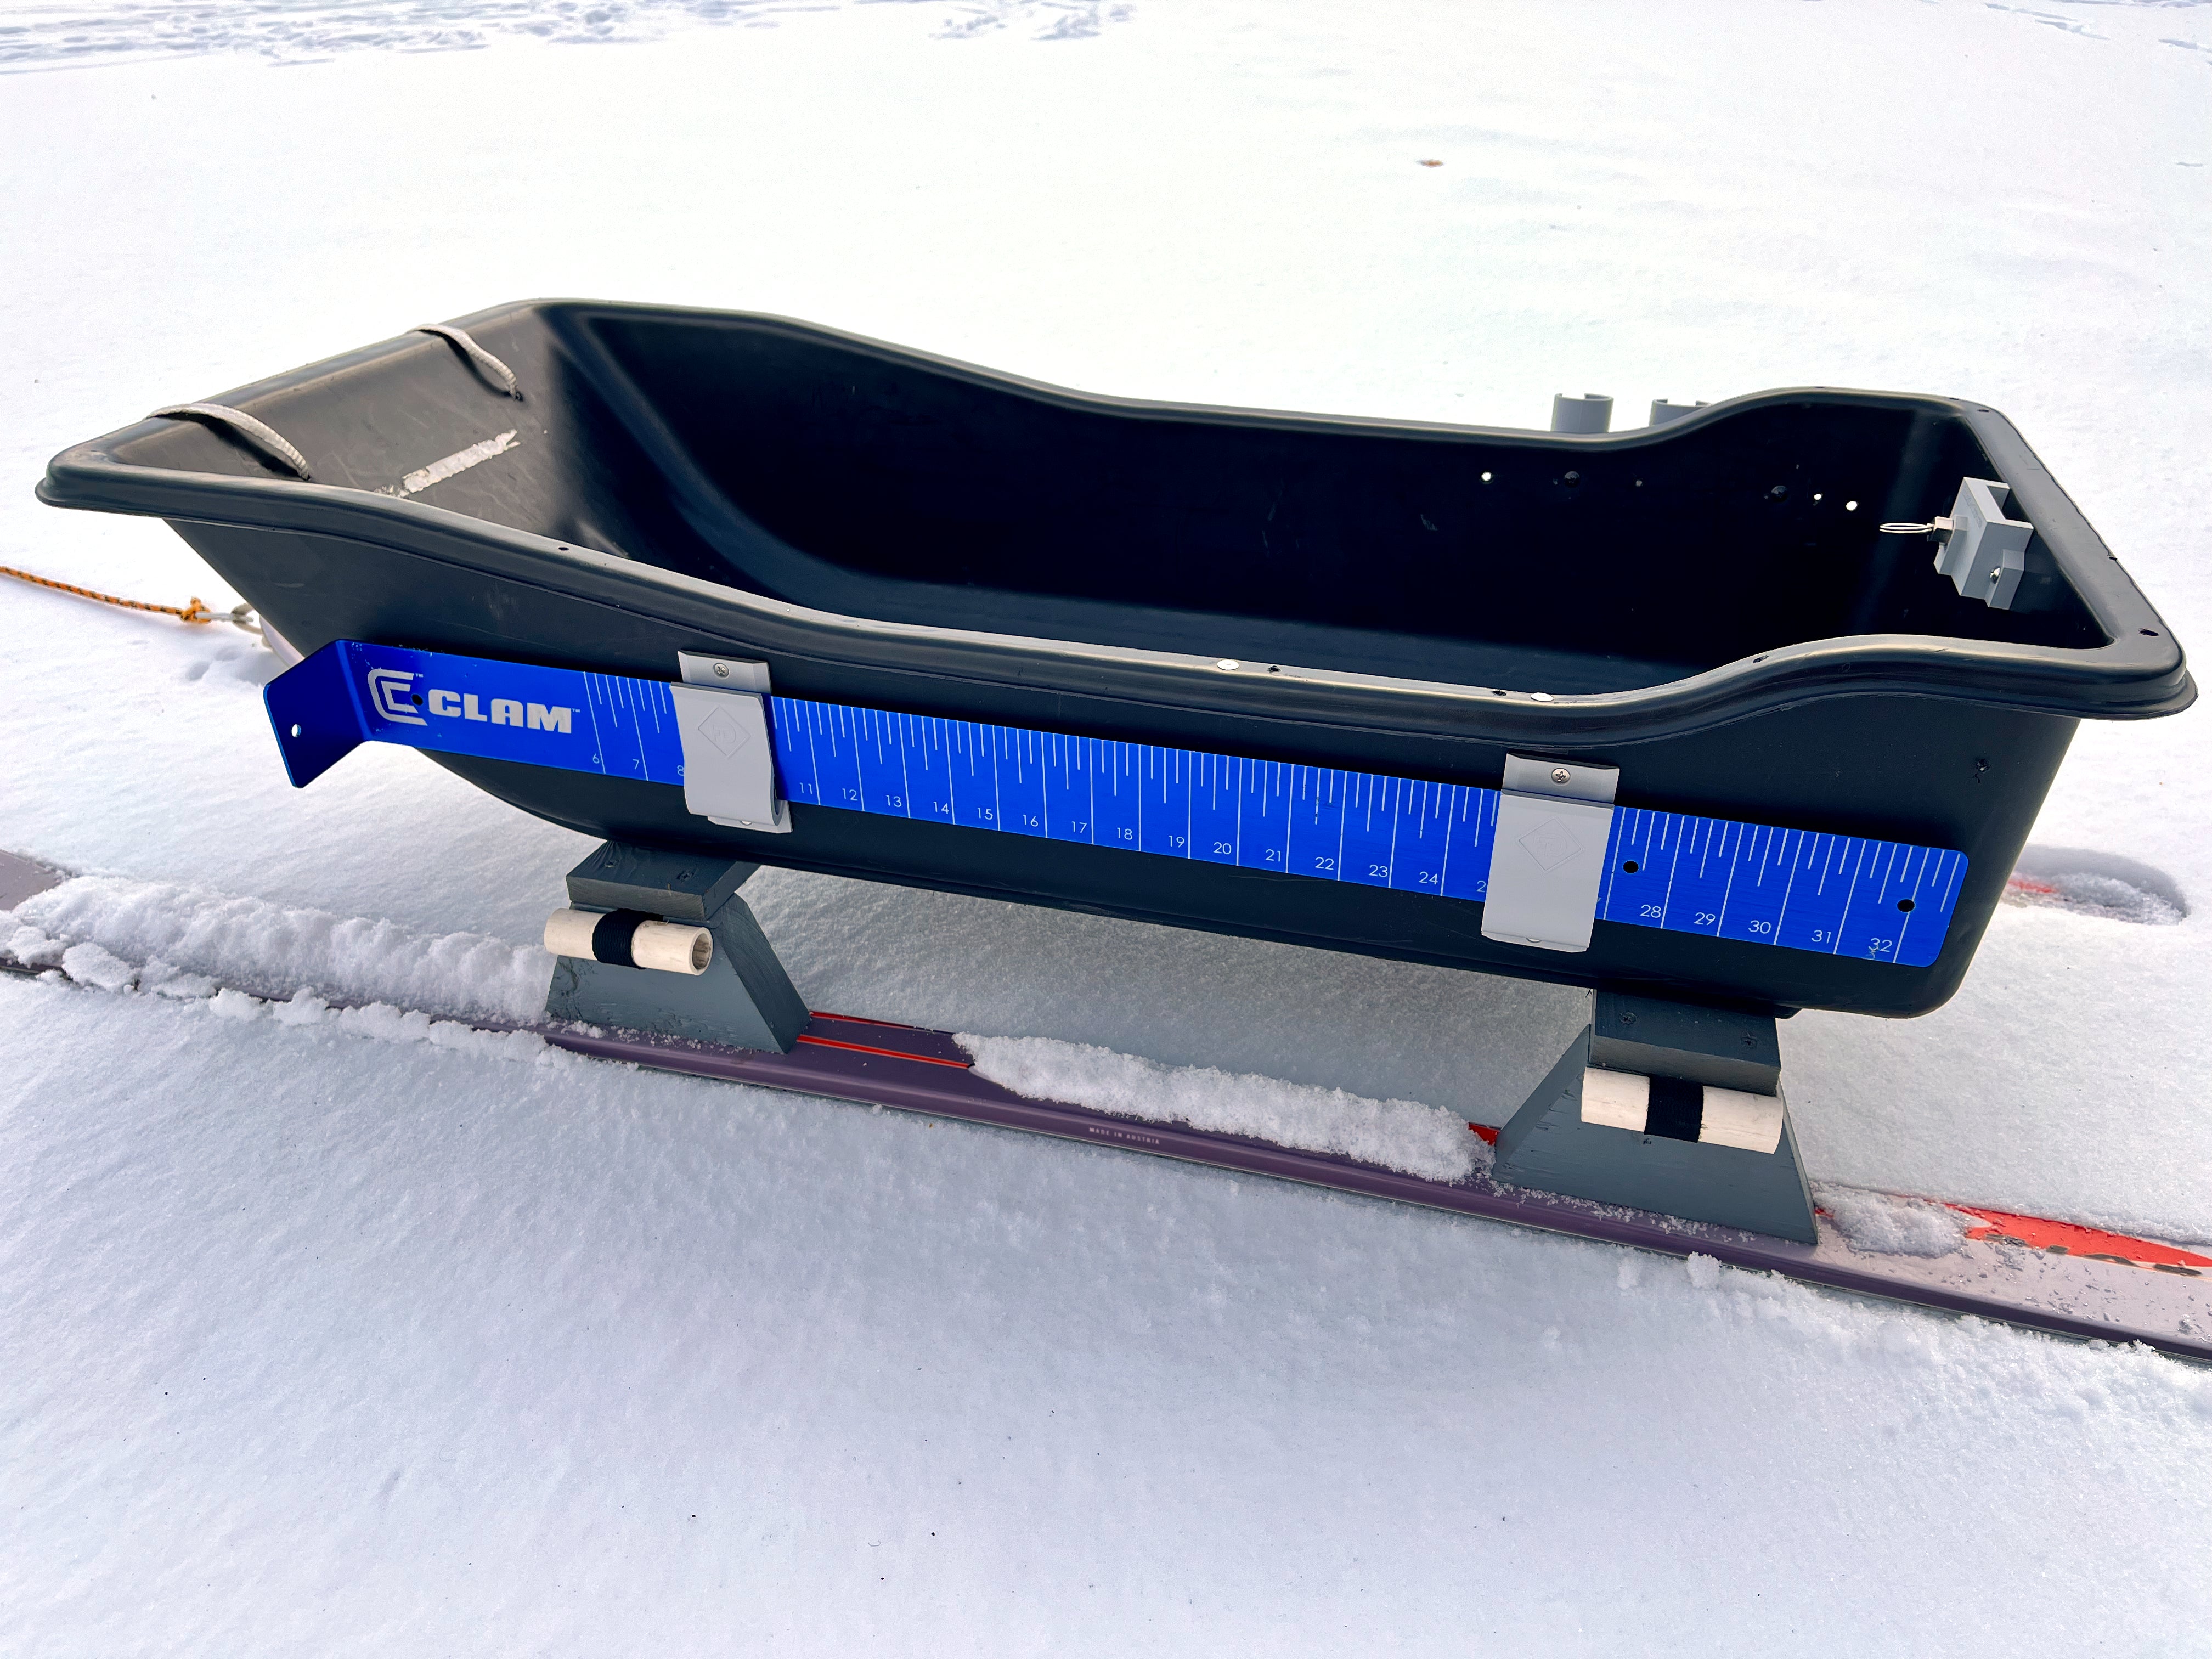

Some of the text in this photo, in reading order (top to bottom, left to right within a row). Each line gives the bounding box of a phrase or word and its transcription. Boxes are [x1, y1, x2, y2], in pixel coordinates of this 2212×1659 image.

[428, 689, 572, 734] CLAM
[592, 753, 600, 765] 6
[633, 759, 640, 770] 7
[799, 782, 812, 795] 11
[842, 788, 857, 802] 12
[886, 795, 902, 808] 13
[933, 801, 950, 814] 14
[977, 807, 994, 820] 15
[1022, 814, 1039, 827] 16
[1071, 821, 1087, 833] 17
[1117, 827, 1133, 840] 18
[1169, 835, 1184, 848] 19
[1213, 842, 1232, 855] 20
[1265, 849, 1281, 862] 21
[1314, 856, 1334, 870] 22
[1368, 864, 1388, 878] 23
[1419, 871, 1438, 885] 24
[1476, 880, 1486, 893] 2
[1640, 904, 1662, 918] 28
[1694, 912, 1716, 926] 29
[1748, 920, 1771, 934] 30
[1811, 929, 1831, 944] 31
[1868, 938, 1892, 952] 32
[1089, 1127, 1109, 1136] MADE
[1127, 1134, 1159, 1144] AUSTRIA
